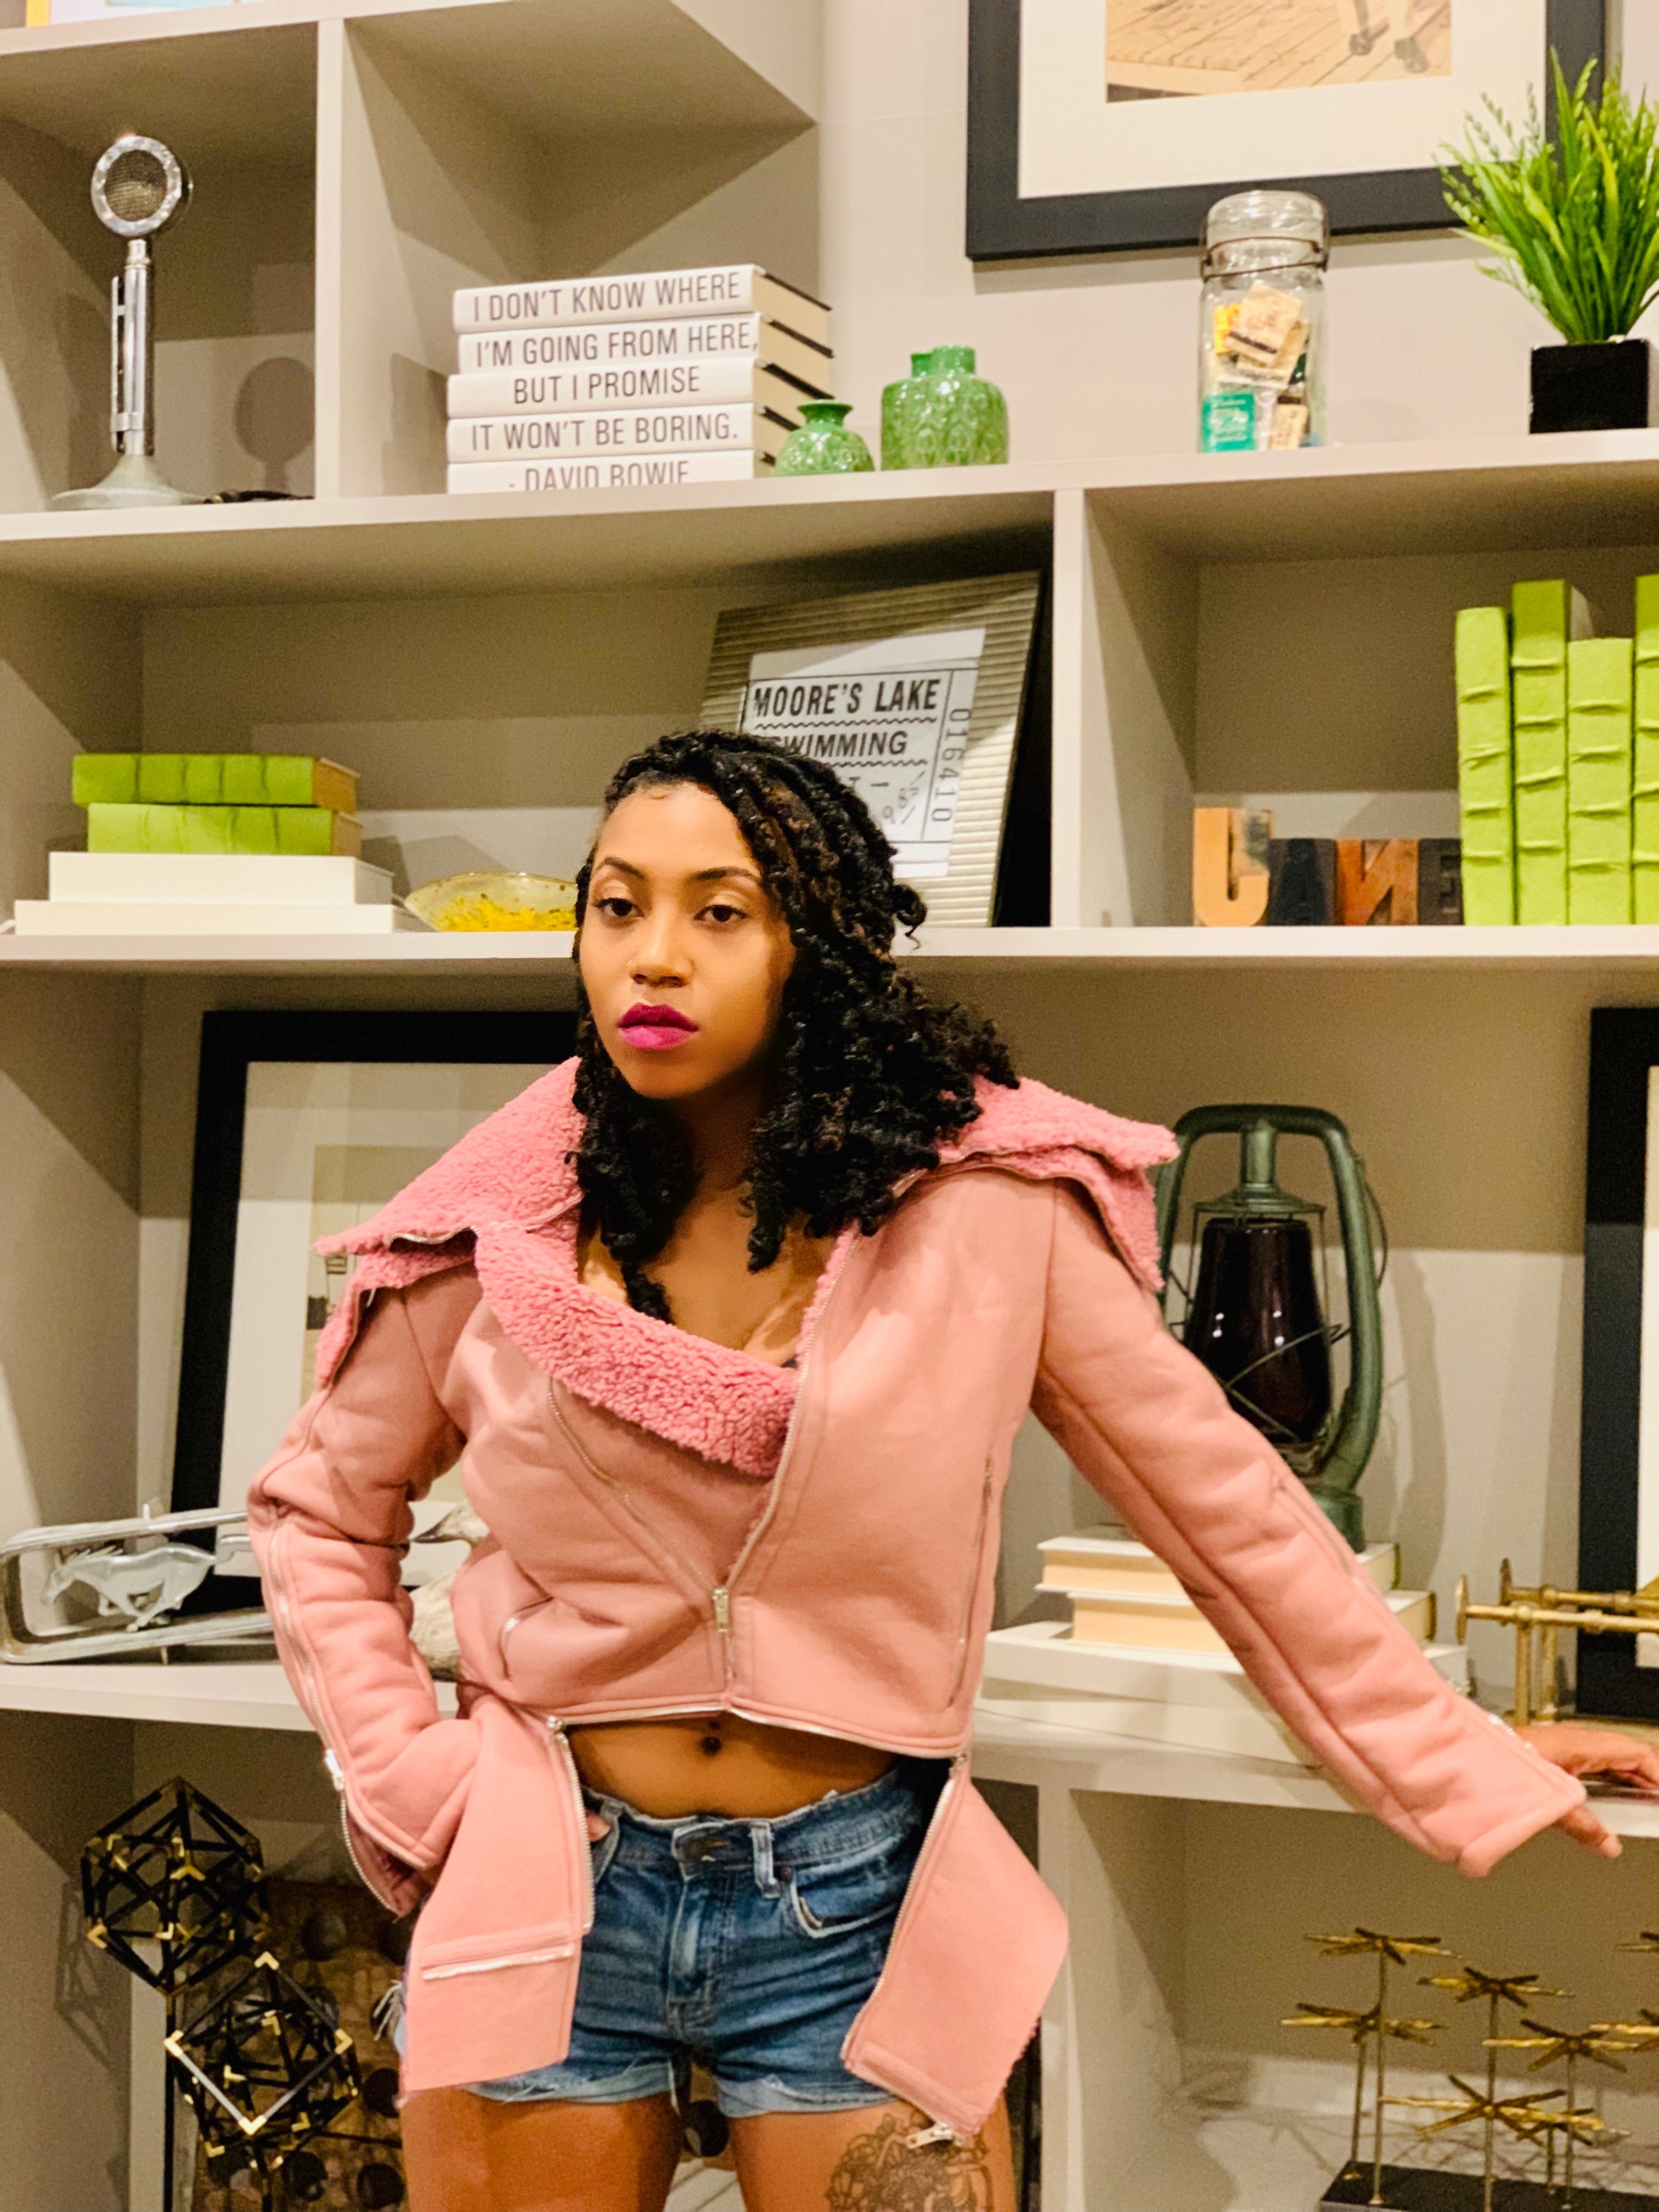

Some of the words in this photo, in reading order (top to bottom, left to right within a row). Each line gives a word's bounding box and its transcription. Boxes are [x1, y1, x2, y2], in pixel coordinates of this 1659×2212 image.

[474, 296, 480, 323] I
[489, 289, 562, 321] DON'T
[572, 281, 646, 313] KNOW
[656, 272, 740, 306] WHERE
[477, 340, 512, 368] I'M
[523, 334, 598, 365] GOING
[608, 328, 678, 358] FROM
[689, 322, 758, 353] HERE,
[514, 376, 562, 405] BUT
[572, 375, 578, 401] I
[588, 366, 699, 400] PROMISE
[472, 424, 494, 450] IT
[504, 420, 585, 449] WON'T
[596, 418, 625, 445] BE
[635, 413, 738, 444] BORING.
[526, 465, 599, 490] DAVID
[754, 682, 862, 717] MOORE'S
[874, 679, 940, 713] LAKE
[768, 730, 909, 758] WIMMING
[932, 708, 972, 822] 016410
